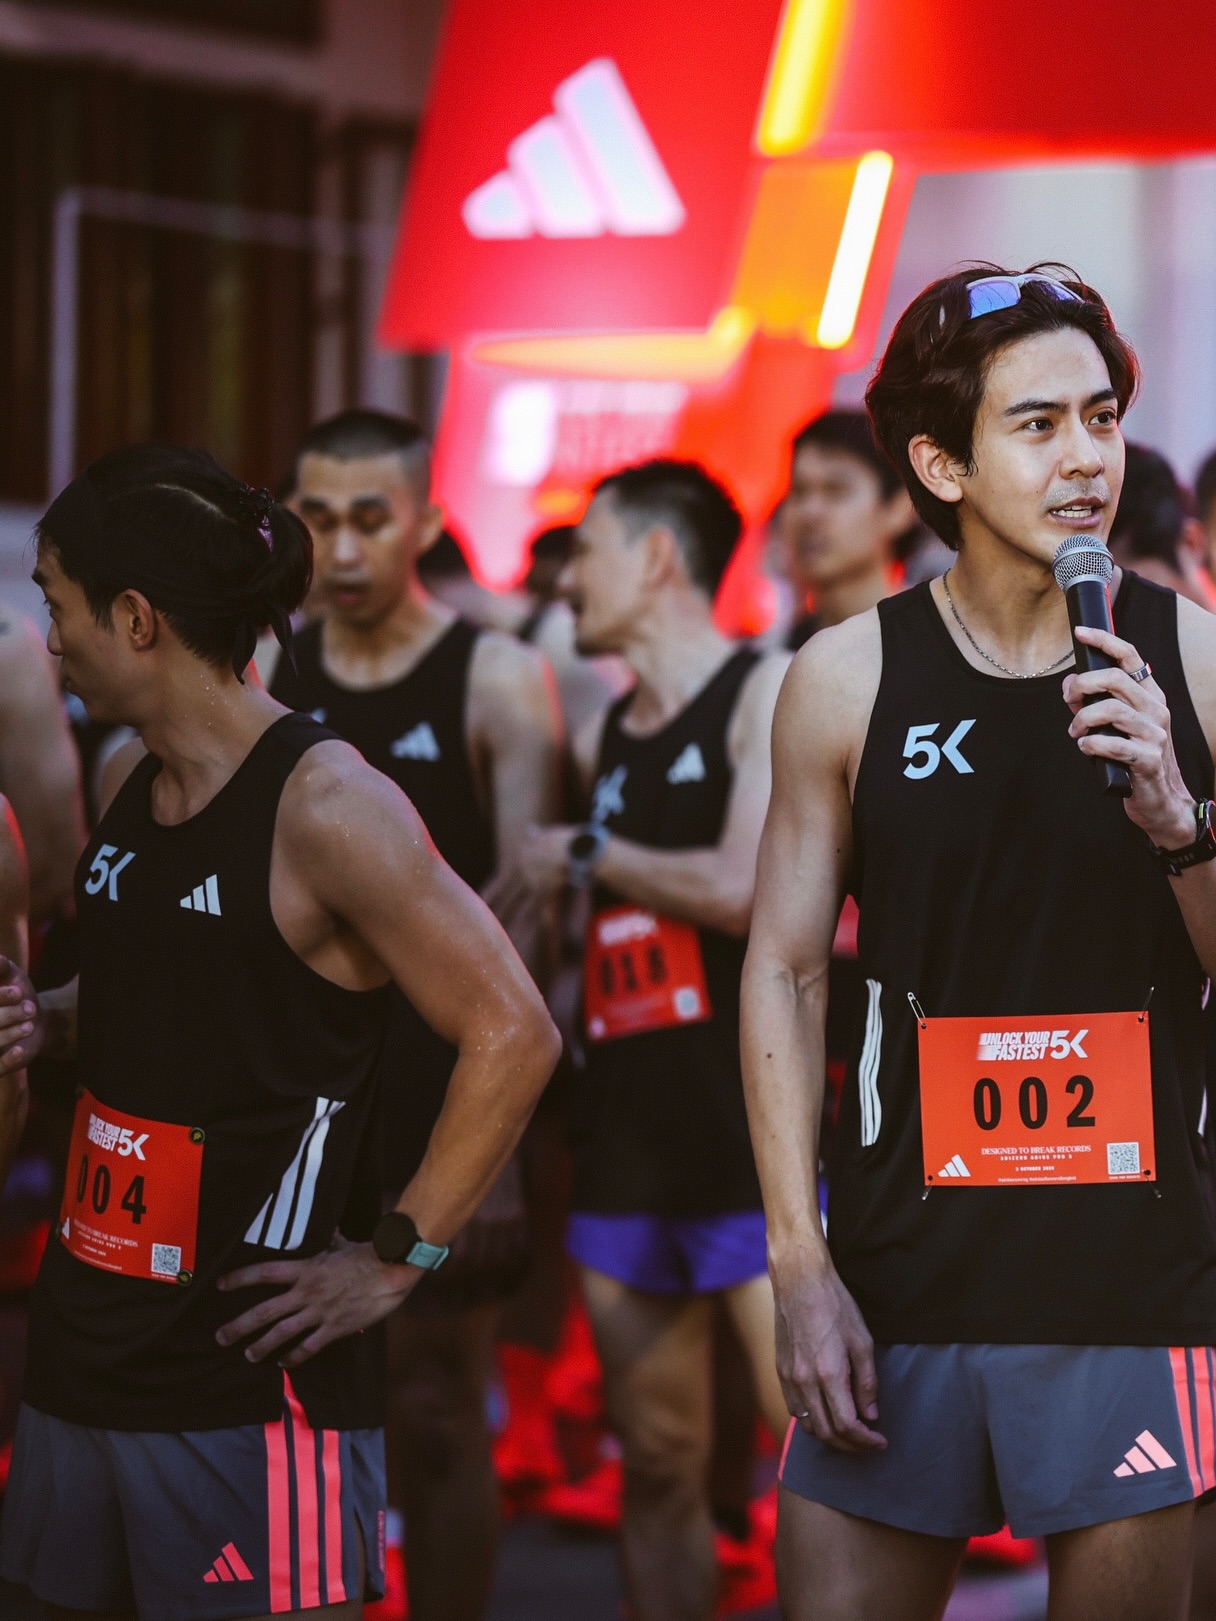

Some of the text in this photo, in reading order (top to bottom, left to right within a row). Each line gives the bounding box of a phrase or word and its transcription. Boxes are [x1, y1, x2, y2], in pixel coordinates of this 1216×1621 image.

[902, 718, 977, 780] 5K
[85, 843, 136, 901] 5K
[979, 1031, 1051, 1046] UNLOCK YOUR
[984, 1029, 1089, 1061] FASTEST 5K
[973, 1075, 1096, 1130] 002
[117, 1128, 150, 1161] 5K
[981, 1145, 1092, 1155] DESIGNED TO BREAK RECORDS
[77, 1155, 147, 1224] 004
